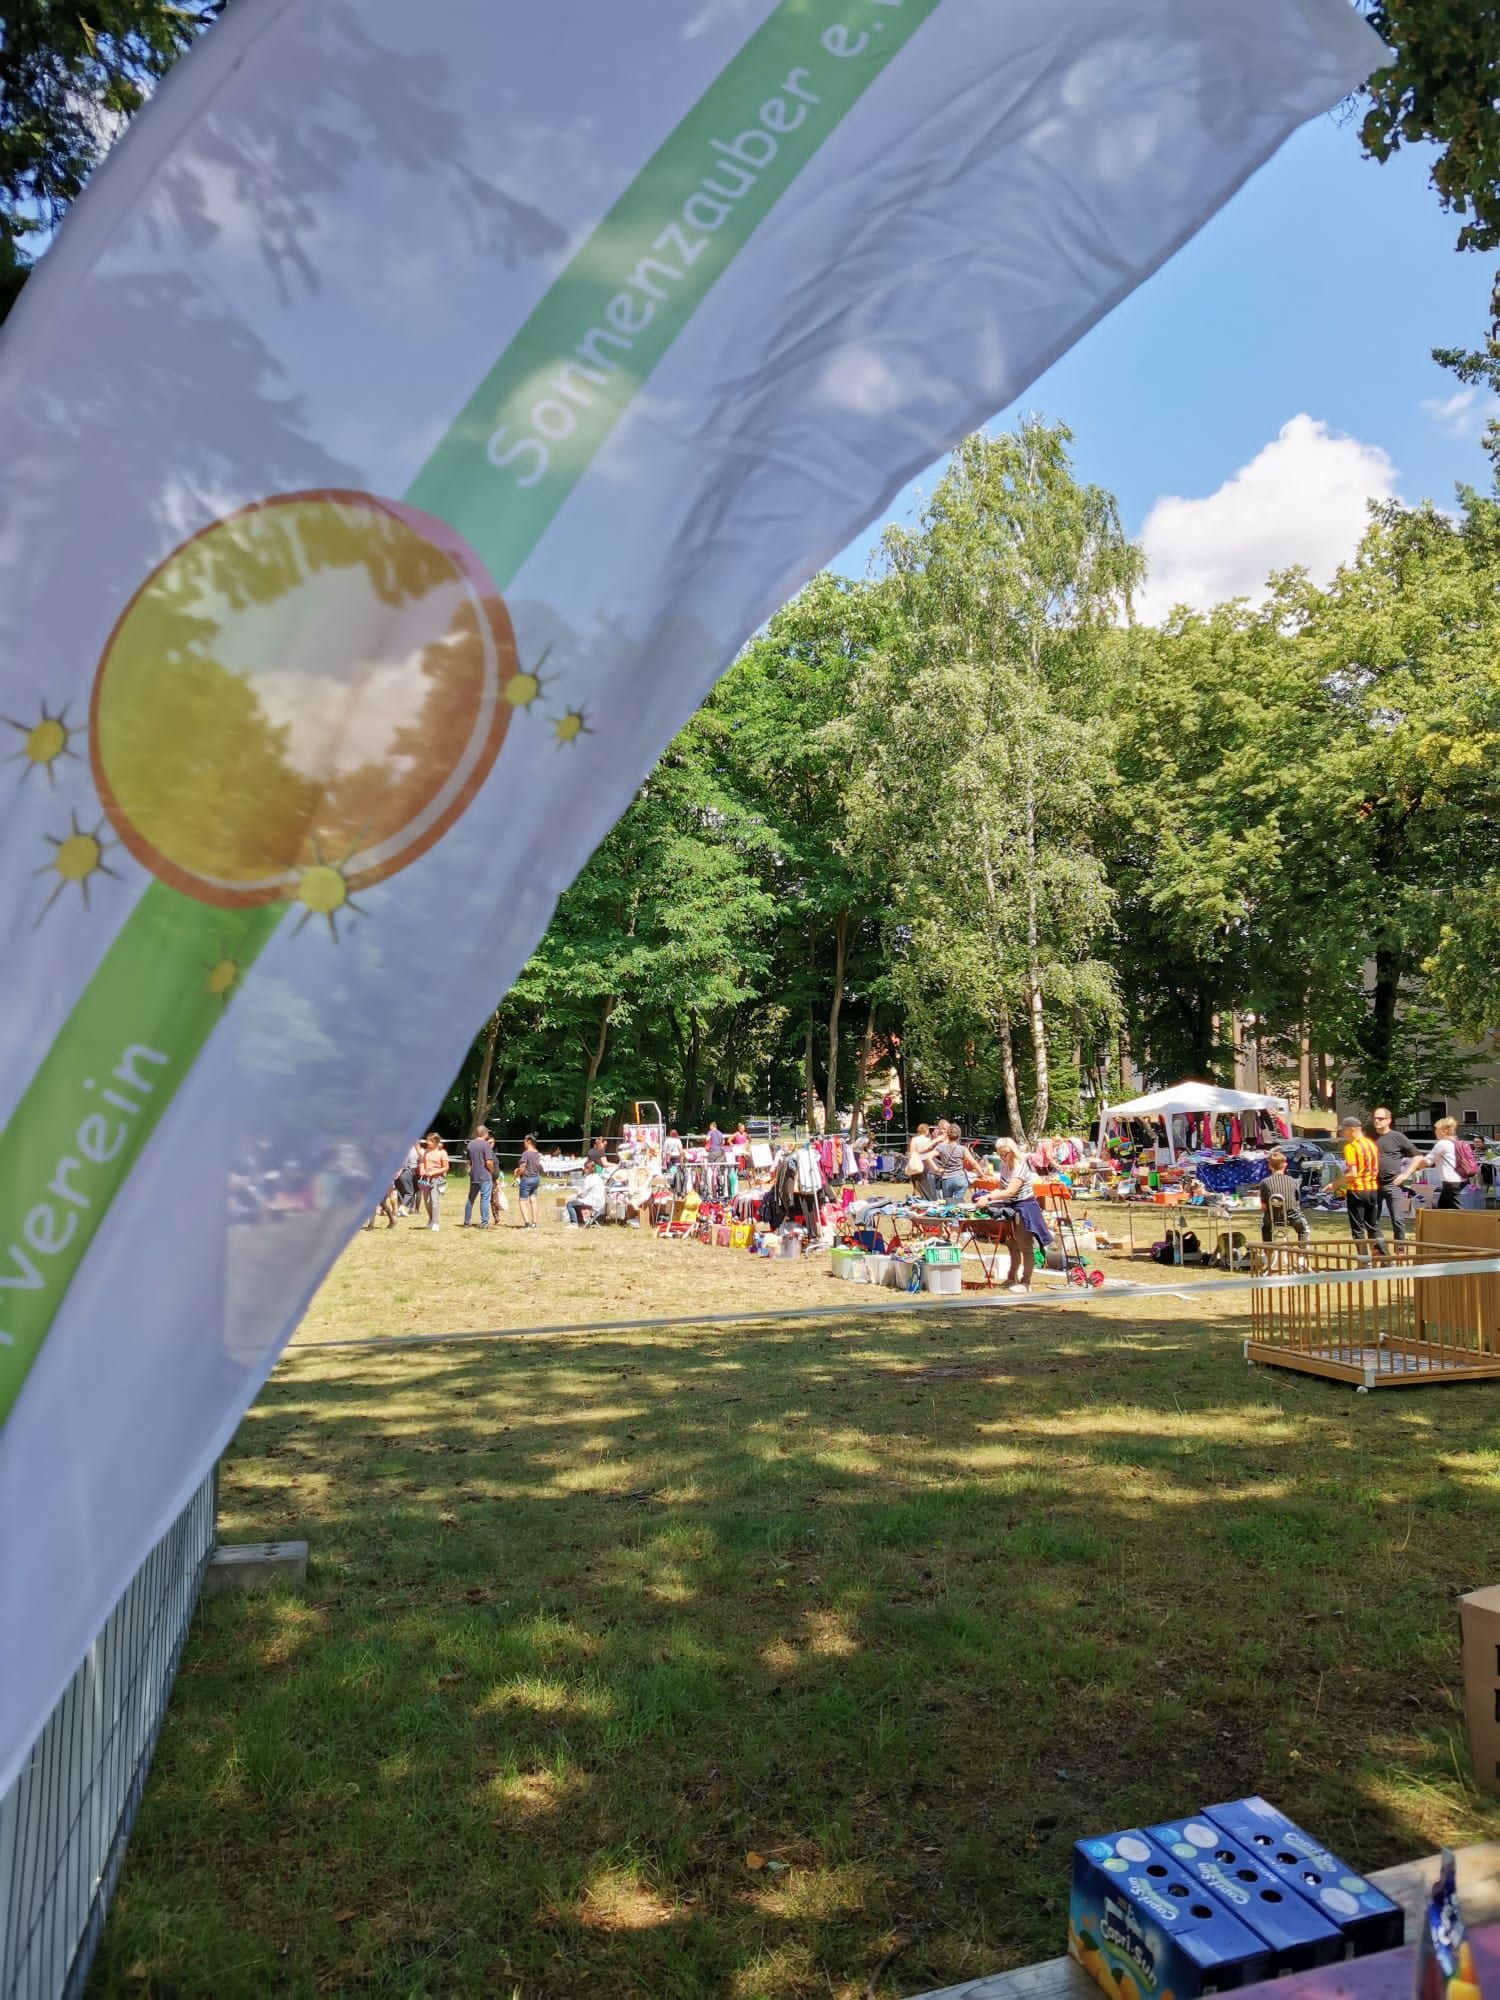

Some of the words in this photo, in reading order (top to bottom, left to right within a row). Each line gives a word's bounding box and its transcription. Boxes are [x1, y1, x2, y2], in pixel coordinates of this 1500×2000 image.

[0, 1043, 169, 1346] verein
[486, 66, 820, 488] Sonnenzauber
[820, 0, 904, 58] e.
